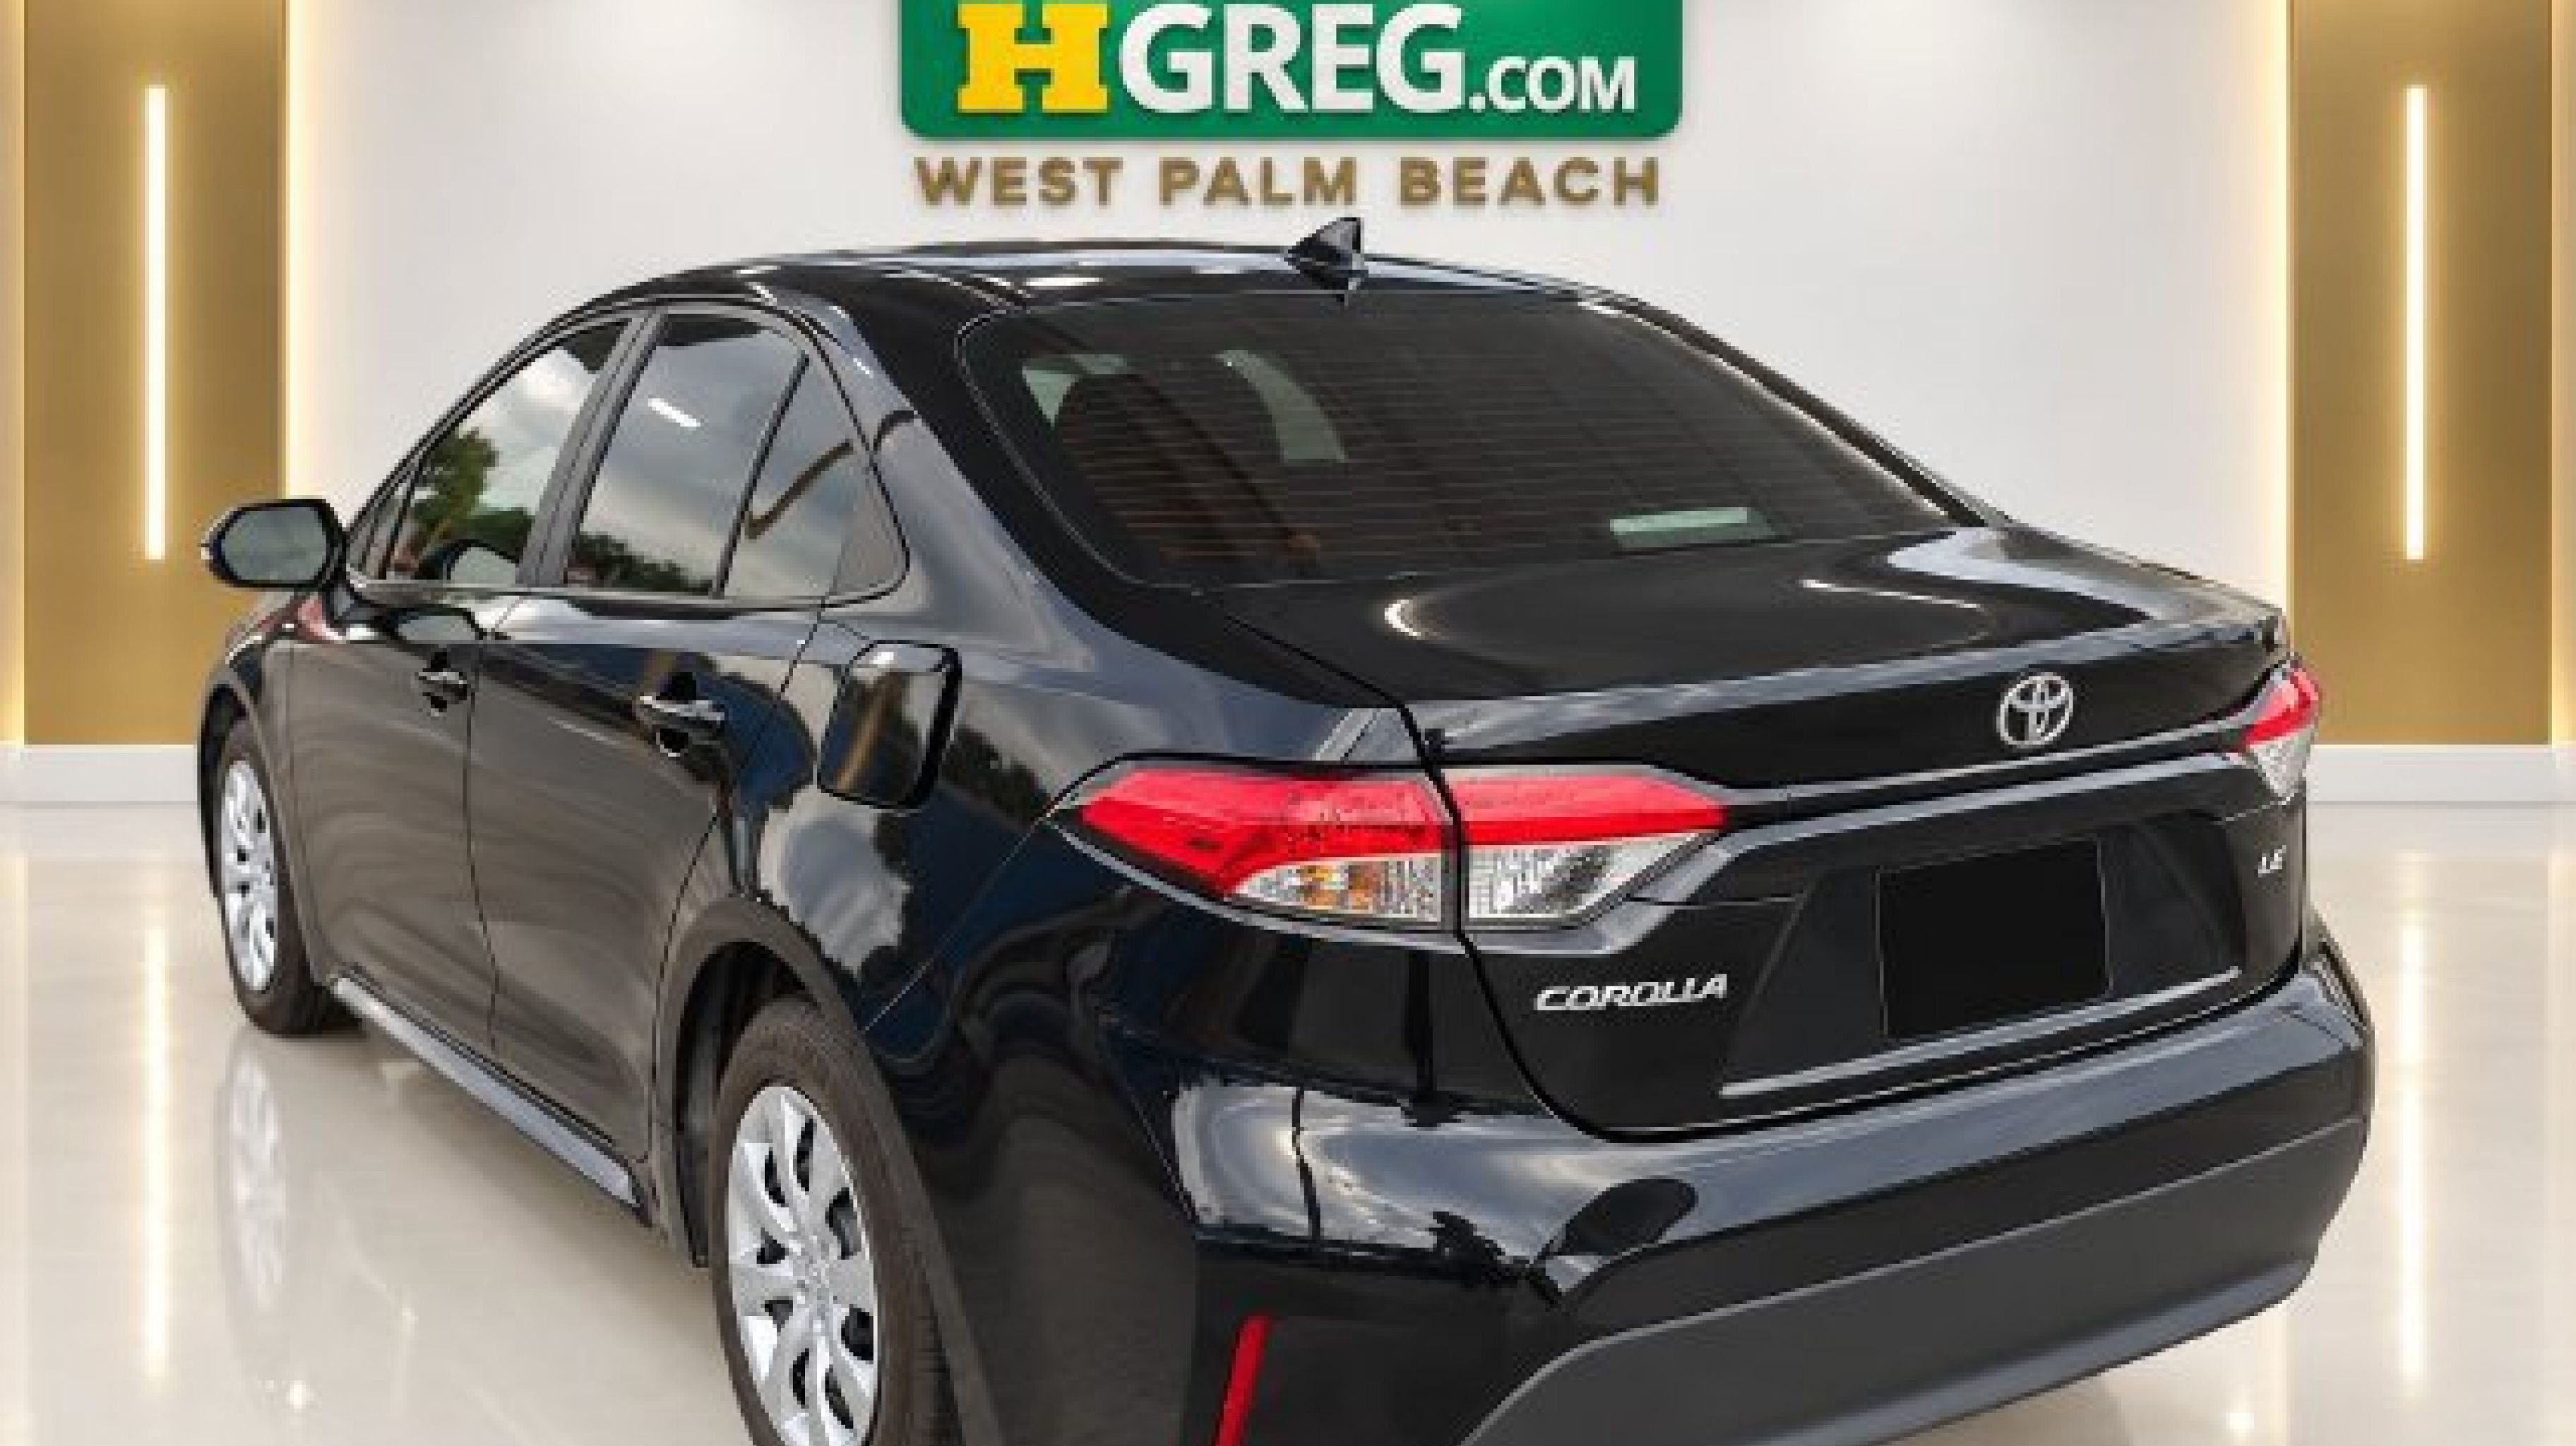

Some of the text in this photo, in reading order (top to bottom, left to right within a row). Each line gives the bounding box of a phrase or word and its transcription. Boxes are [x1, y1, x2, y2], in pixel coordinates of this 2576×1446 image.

[914, 156, 1659, 207] WEST PALM BEACH
[1534, 974, 1727, 1010] COROLLA
